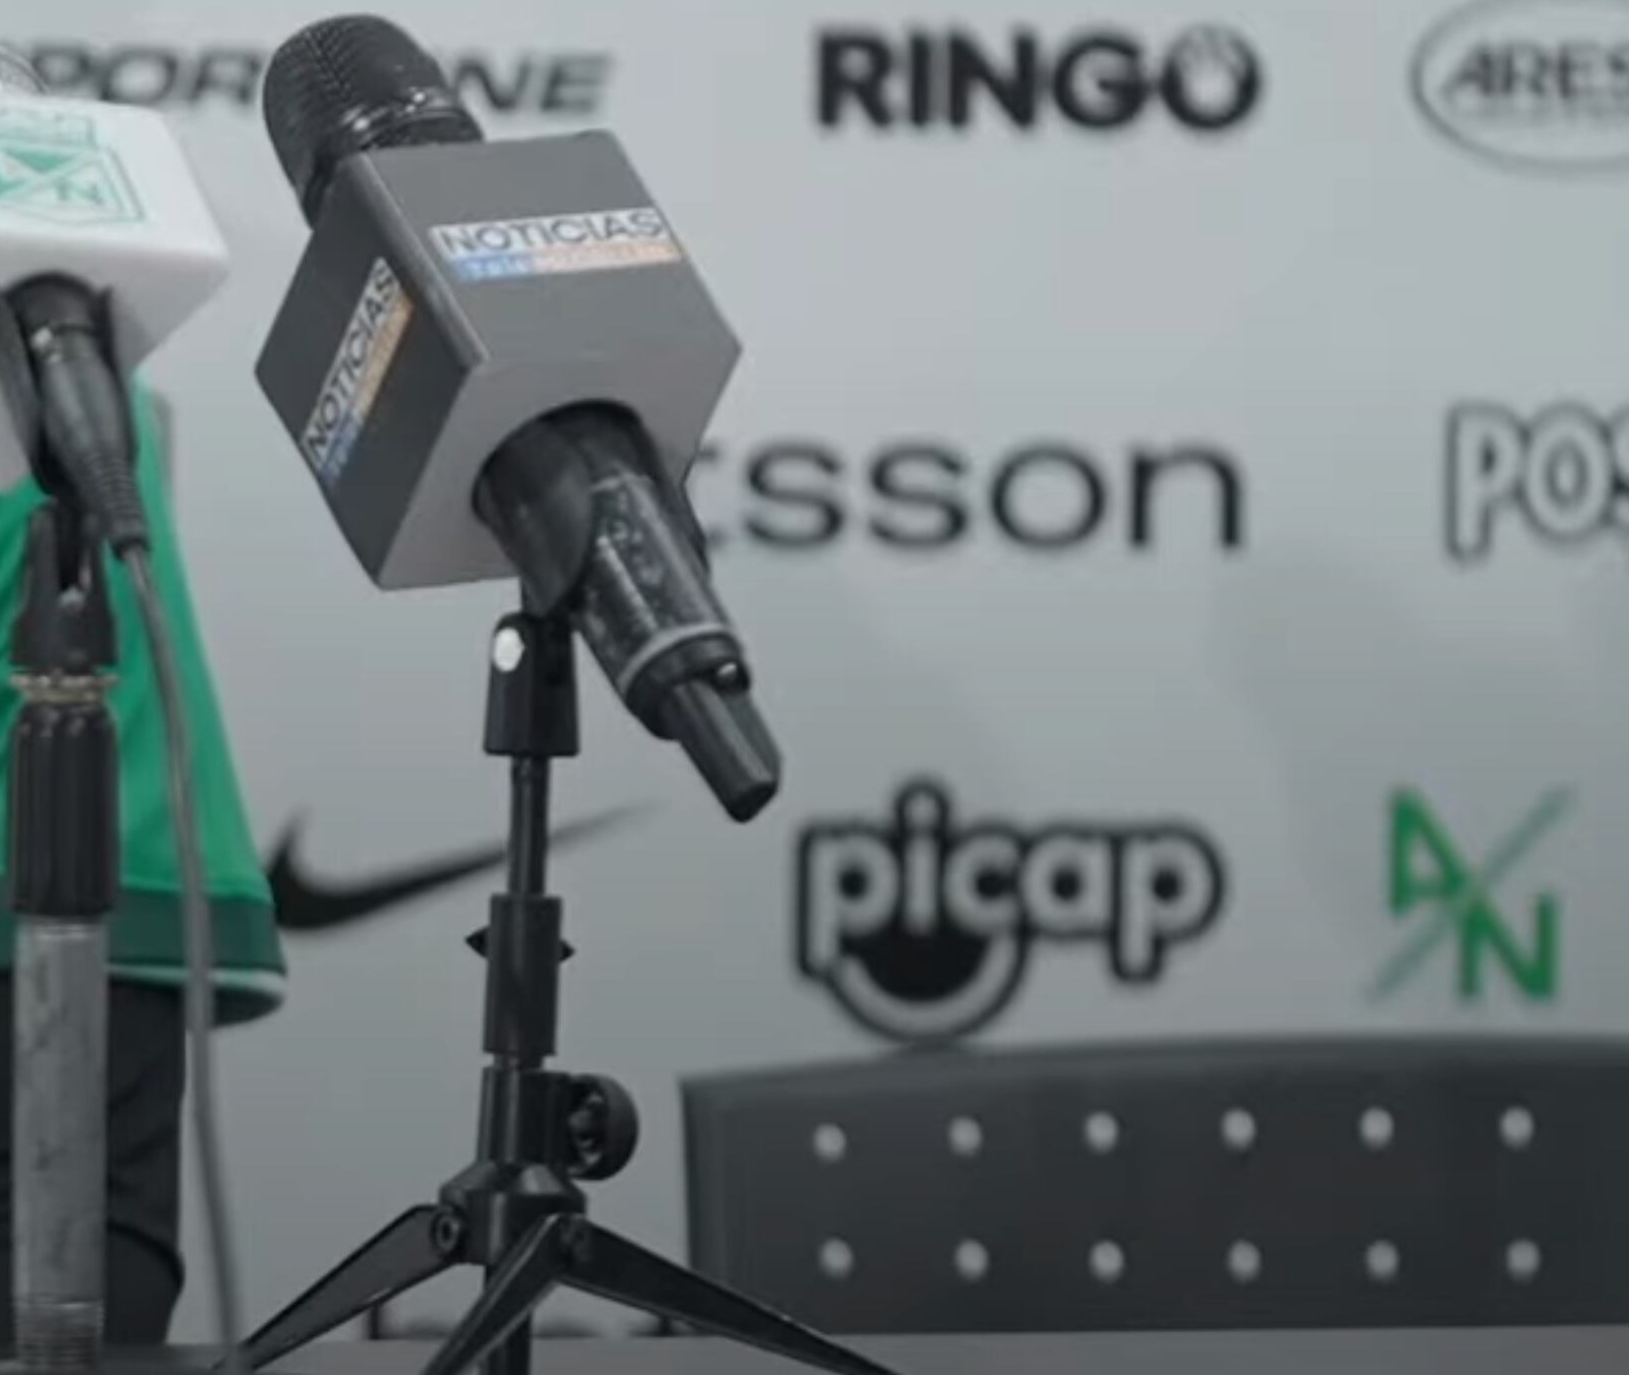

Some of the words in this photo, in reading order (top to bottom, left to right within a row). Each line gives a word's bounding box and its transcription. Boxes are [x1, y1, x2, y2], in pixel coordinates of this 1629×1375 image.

[816, 27, 1262, 134] RINGO
[441, 210, 664, 254] NOTICIAS
[306, 264, 396, 462] NOTICIAS
[687, 436, 1245, 552] sson
[1443, 402, 1629, 564] PO
[796, 778, 1225, 982] picap
